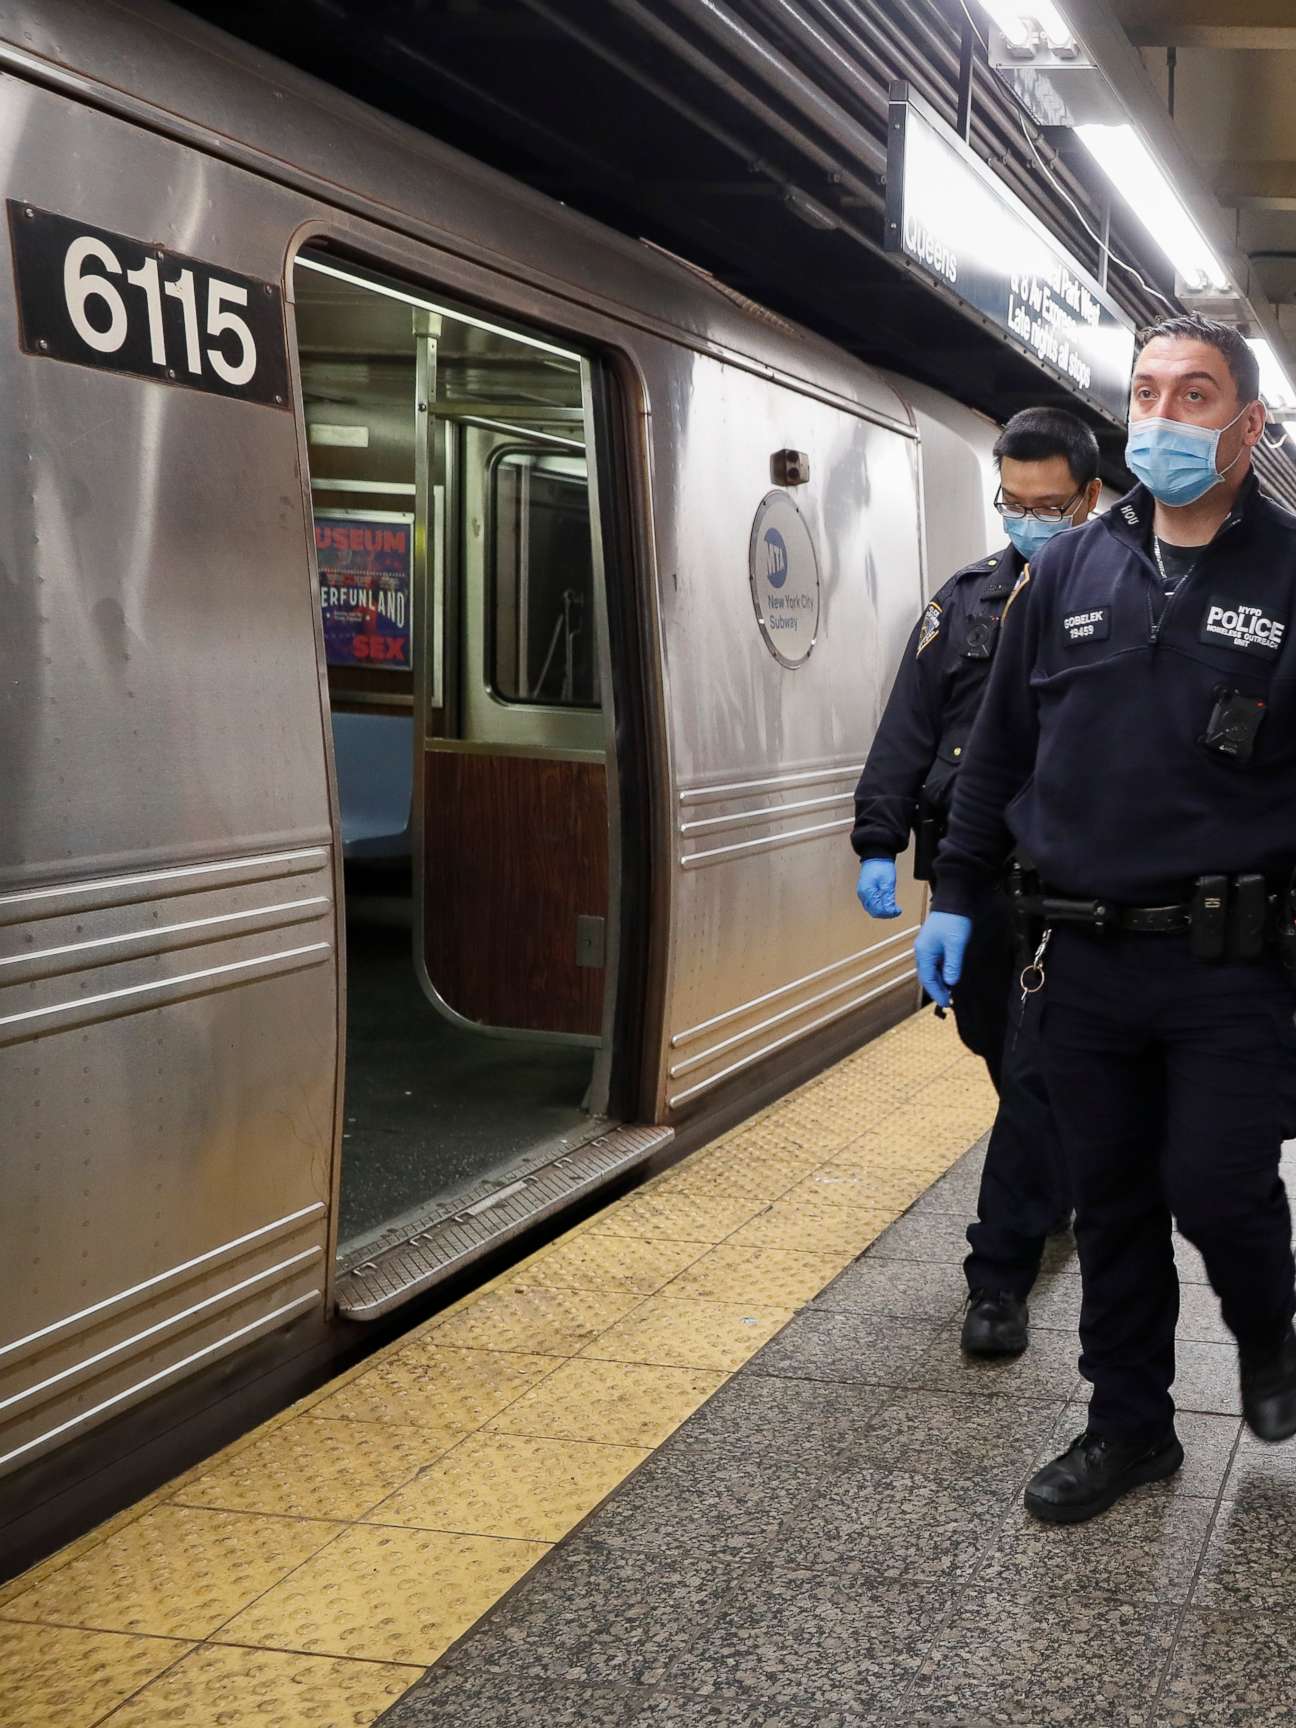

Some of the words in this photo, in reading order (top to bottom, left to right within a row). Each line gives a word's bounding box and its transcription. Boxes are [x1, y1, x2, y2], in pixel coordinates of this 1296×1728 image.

[905, 213, 958, 283] Queens
[64, 235, 257, 385] 6115
[1008, 293, 1031, 341] Late
[1031, 318, 1058, 363] nights
[1058, 341, 1070, 372] all
[1069, 350, 1091, 389] stops
[1120, 504, 1140, 525] HOU
[315, 527, 406, 554] USEUM
[320, 586, 405, 629] ERFUNLAND
[768, 594, 784, 609] New
[785, 594, 800, 609] York
[801, 594, 815, 612] City
[1238, 605, 1262, 617] NYPD
[769, 614, 799, 631] Subway
[1207, 606, 1285, 643] POLICE
[353, 635, 405, 663] SEX
[1244, 633, 1279, 650] OUTREACH
